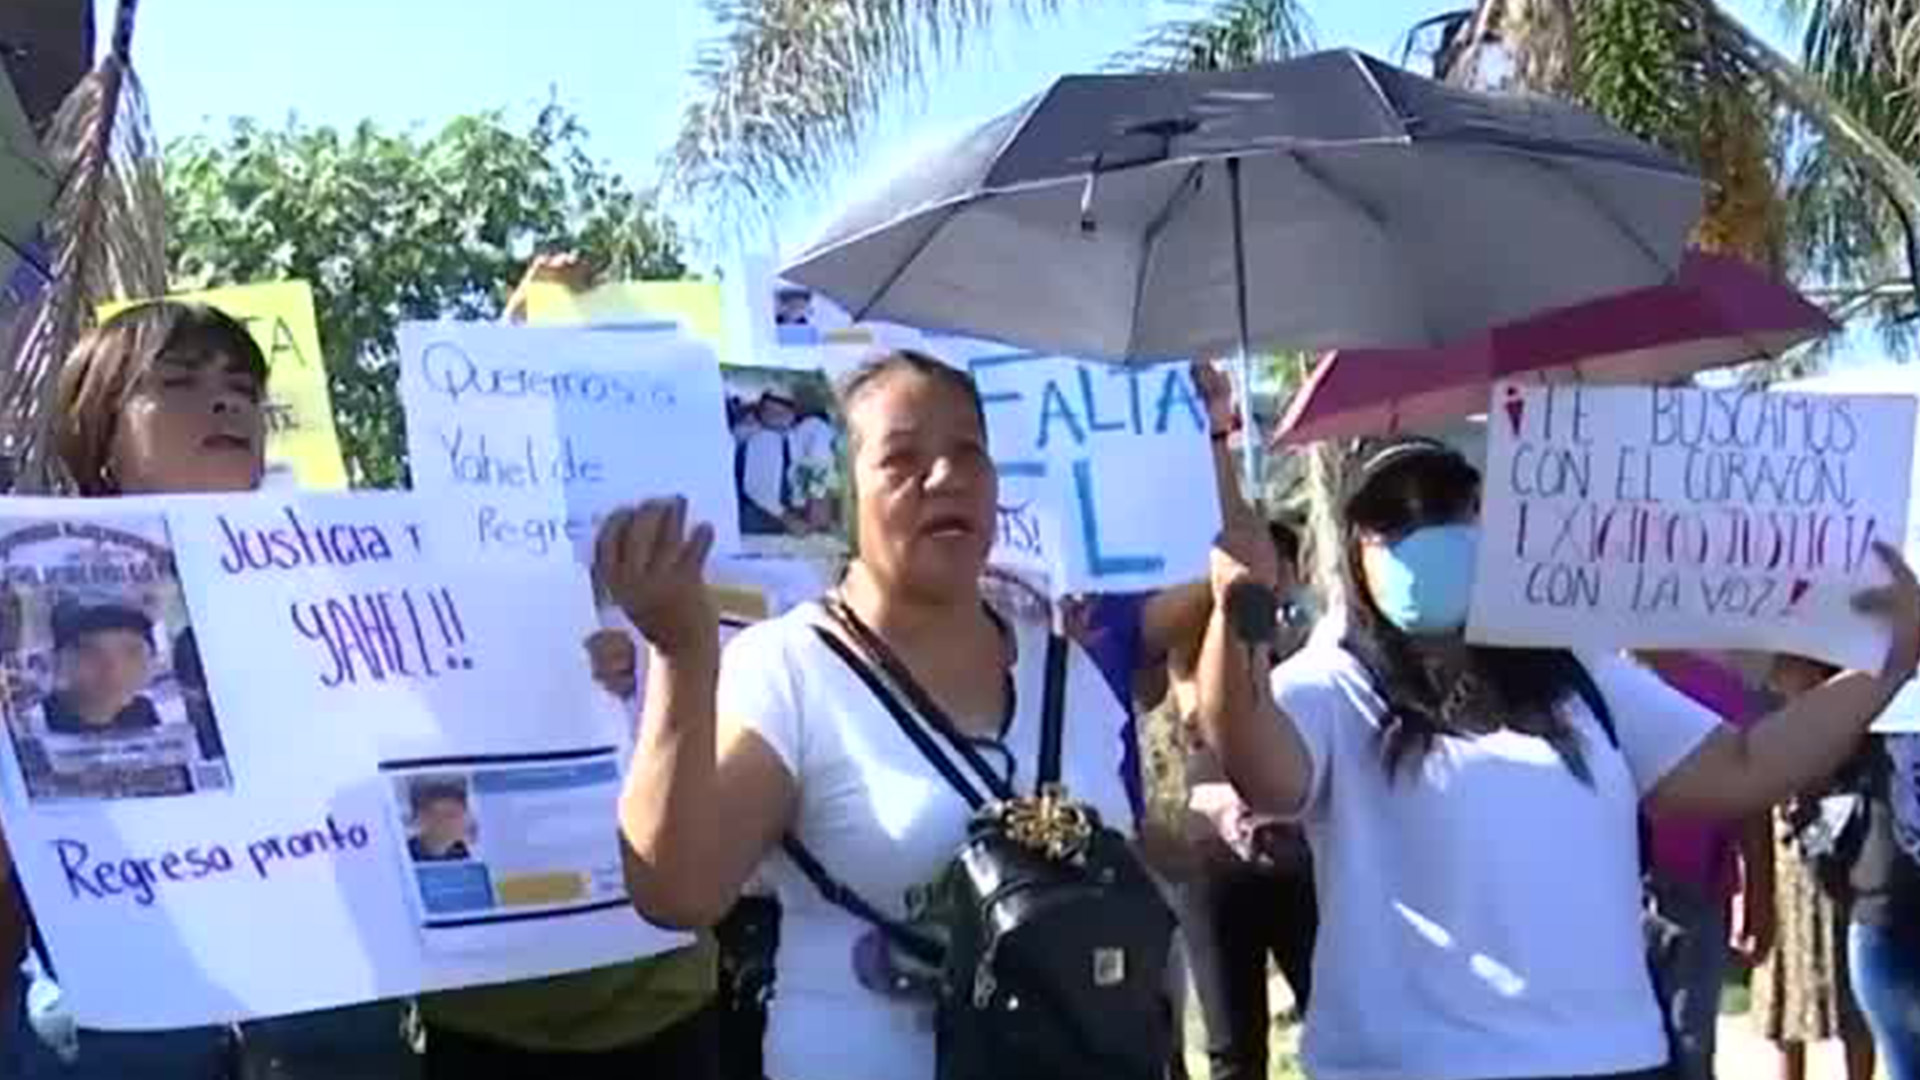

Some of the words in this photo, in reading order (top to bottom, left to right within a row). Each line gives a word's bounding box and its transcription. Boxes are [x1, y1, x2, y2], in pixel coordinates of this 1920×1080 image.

[968, 352, 1206, 449] FALTA
[1650, 386, 1857, 452] BUSCAMOS
[441, 424, 540, 486] Yahel
[551, 436, 604, 483] de
[1511, 443, 1592, 499] CON
[1616, 446, 1662, 502] EL
[217, 506, 393, 574] Justicia
[1526, 562, 1600, 606] CON
[1631, 562, 1681, 611] LA
[291, 587, 474, 687] YAHEL!!
[249, 813, 369, 880] pronto
